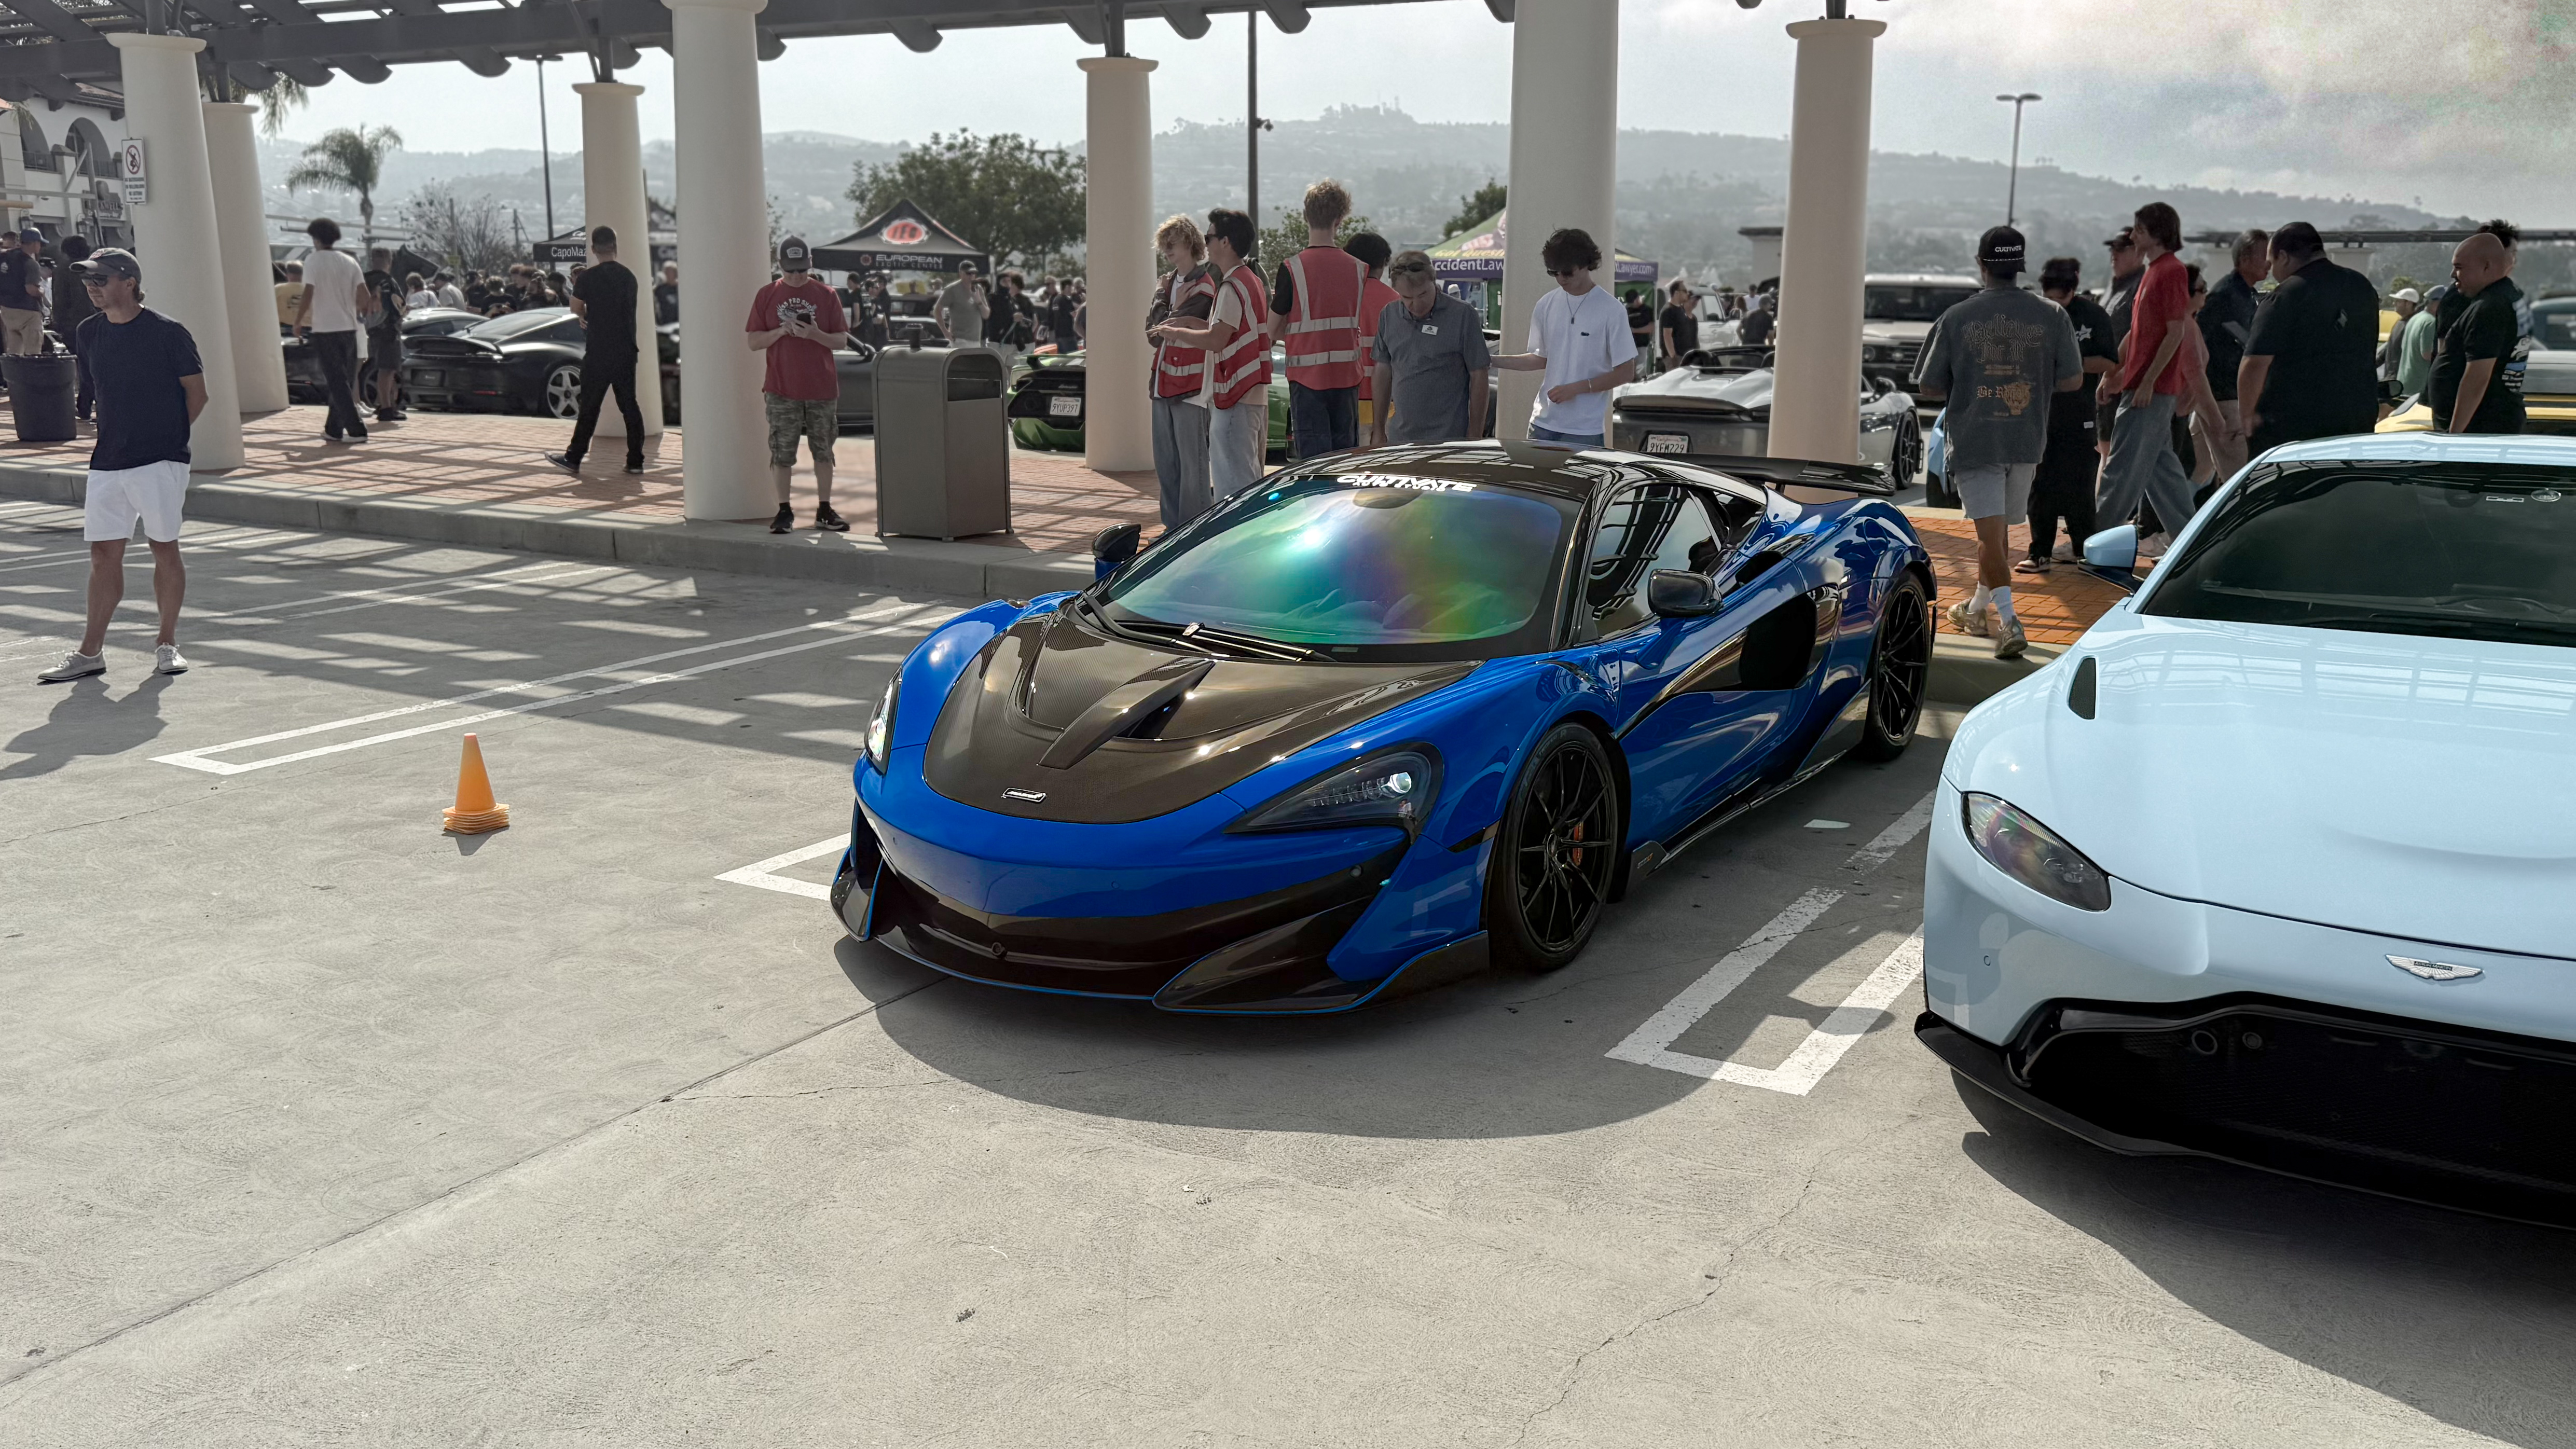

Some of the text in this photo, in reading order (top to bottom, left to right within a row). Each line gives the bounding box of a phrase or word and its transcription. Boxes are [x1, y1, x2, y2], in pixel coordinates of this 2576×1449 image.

[876, 254, 942, 264] EUROPEAN
[1431, 258, 1504, 271] ccidentLaw
[1337, 475, 1478, 492] CULTIVATE
